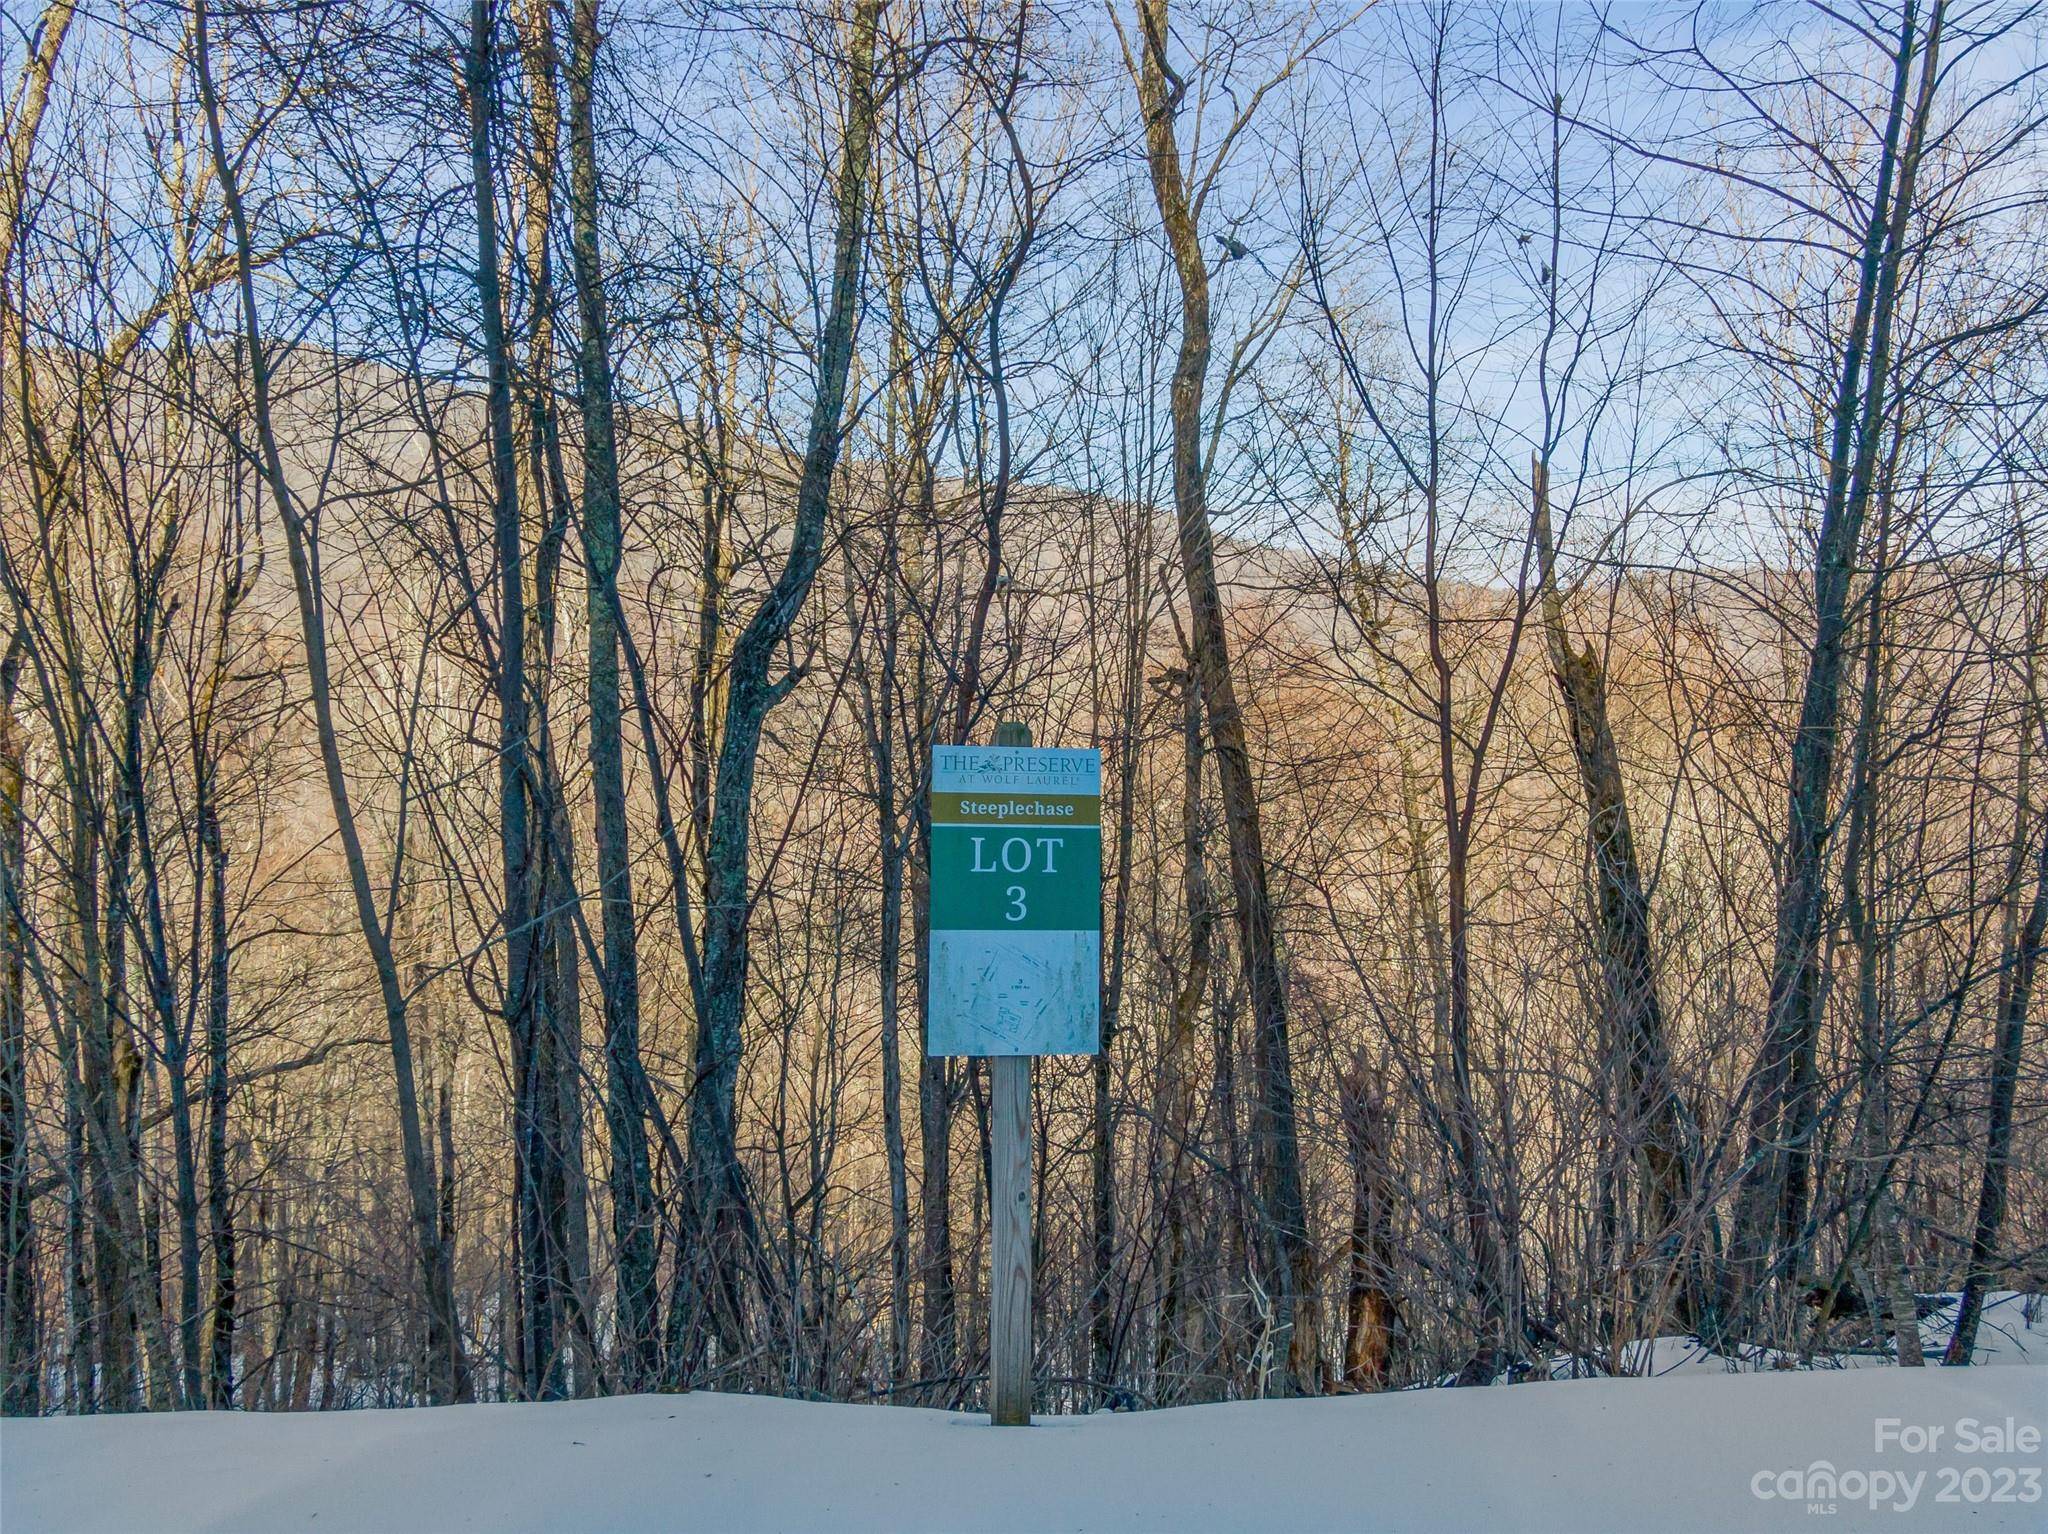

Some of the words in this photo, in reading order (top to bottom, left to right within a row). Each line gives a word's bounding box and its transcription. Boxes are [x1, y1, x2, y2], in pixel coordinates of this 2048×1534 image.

[940, 754, 980, 772] THE
[1004, 756, 1096, 773] PRESERVE
[959, 774, 974, 785] AT
[982, 775, 1020, 785] WOLF
[1027, 775, 1079, 786] LAUREL
[960, 800, 1074, 819] Steeplechase
[970, 836, 1064, 873] LOT
[1005, 885, 1028, 922] 3
